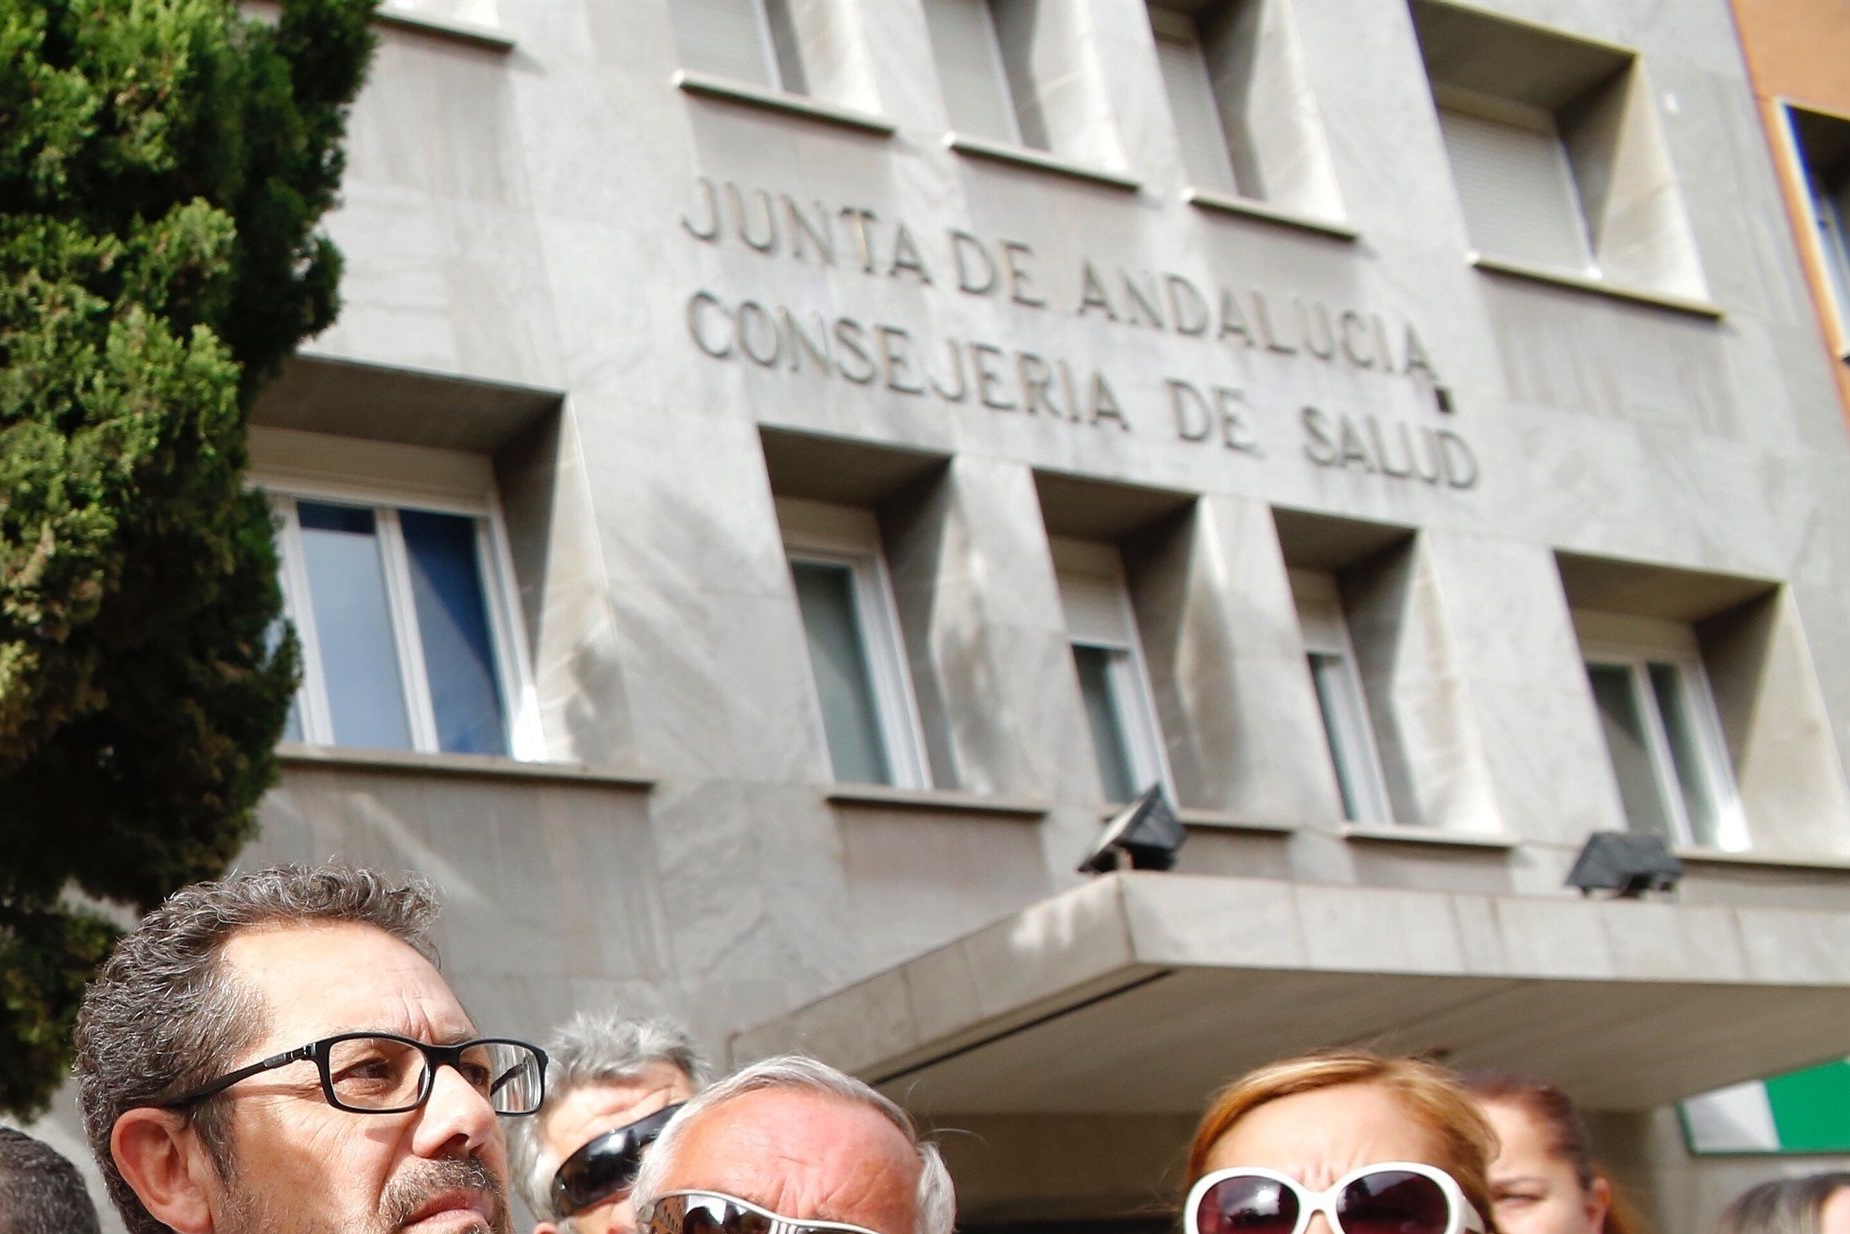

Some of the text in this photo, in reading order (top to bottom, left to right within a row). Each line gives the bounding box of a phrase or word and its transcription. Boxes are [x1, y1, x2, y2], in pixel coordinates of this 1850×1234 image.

[681, 175, 1441, 382] JUNTA DE ANDALUCIA
[686, 290, 1481, 491] CONSEJERIA DE SALUD
